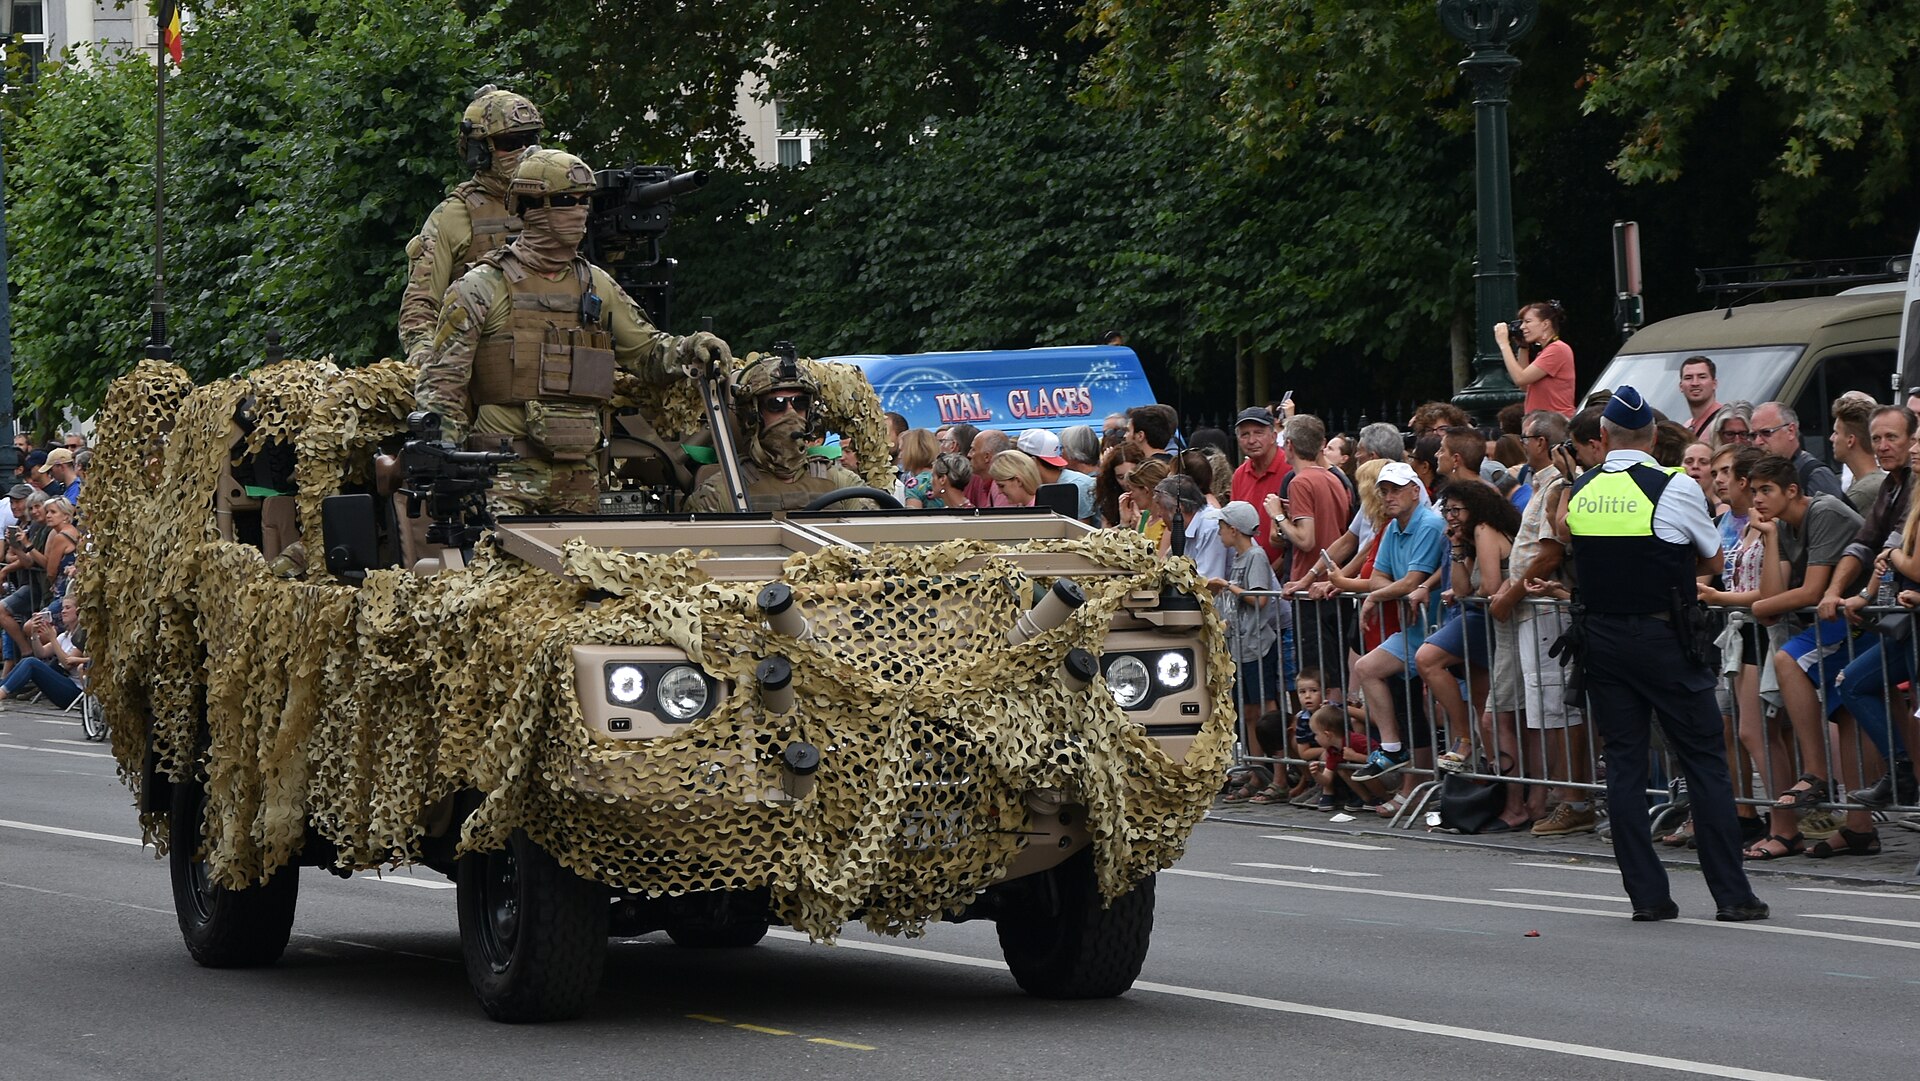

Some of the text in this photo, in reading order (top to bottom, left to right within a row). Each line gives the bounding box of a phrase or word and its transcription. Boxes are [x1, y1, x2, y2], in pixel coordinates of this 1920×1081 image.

[935, 387, 1093, 423] ITAL GLACES
[1576, 495, 1638, 513] Politie
